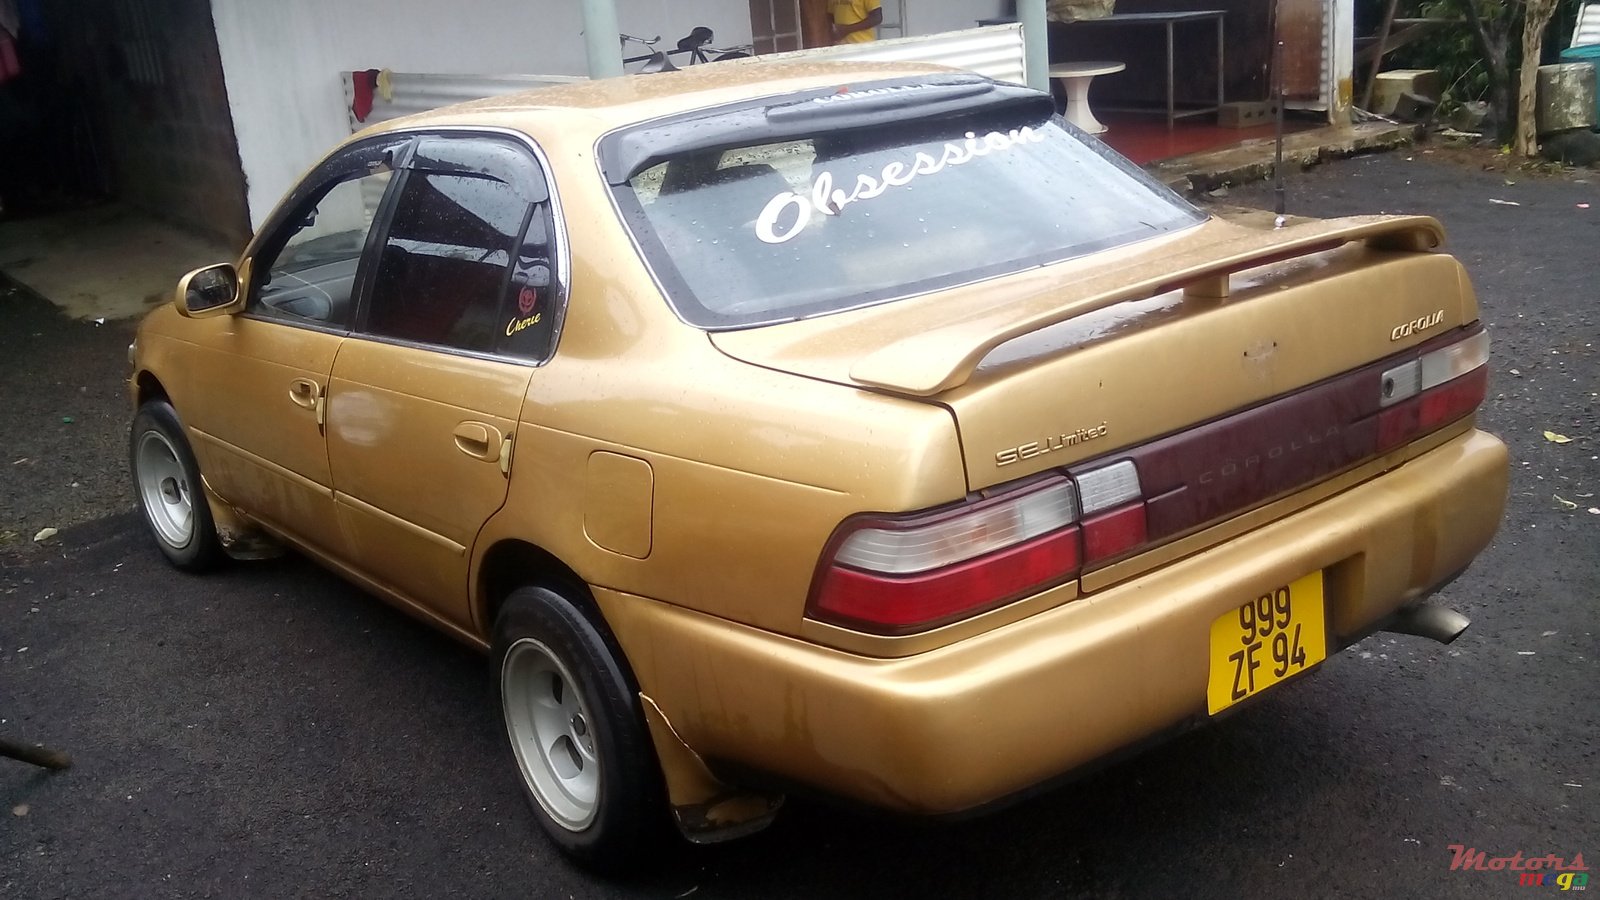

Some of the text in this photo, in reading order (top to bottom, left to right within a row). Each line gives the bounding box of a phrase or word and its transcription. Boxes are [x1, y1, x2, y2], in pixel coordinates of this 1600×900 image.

[755, 125, 1045, 243] Obsession
[505, 312, 541, 337] Cherie
[1390, 309, 1444, 341] COROLLA
[1199, 426, 1340, 484] COROLLA
[1239, 585, 1291, 645] 999
[1229, 623, 1306, 701] ZF 94
